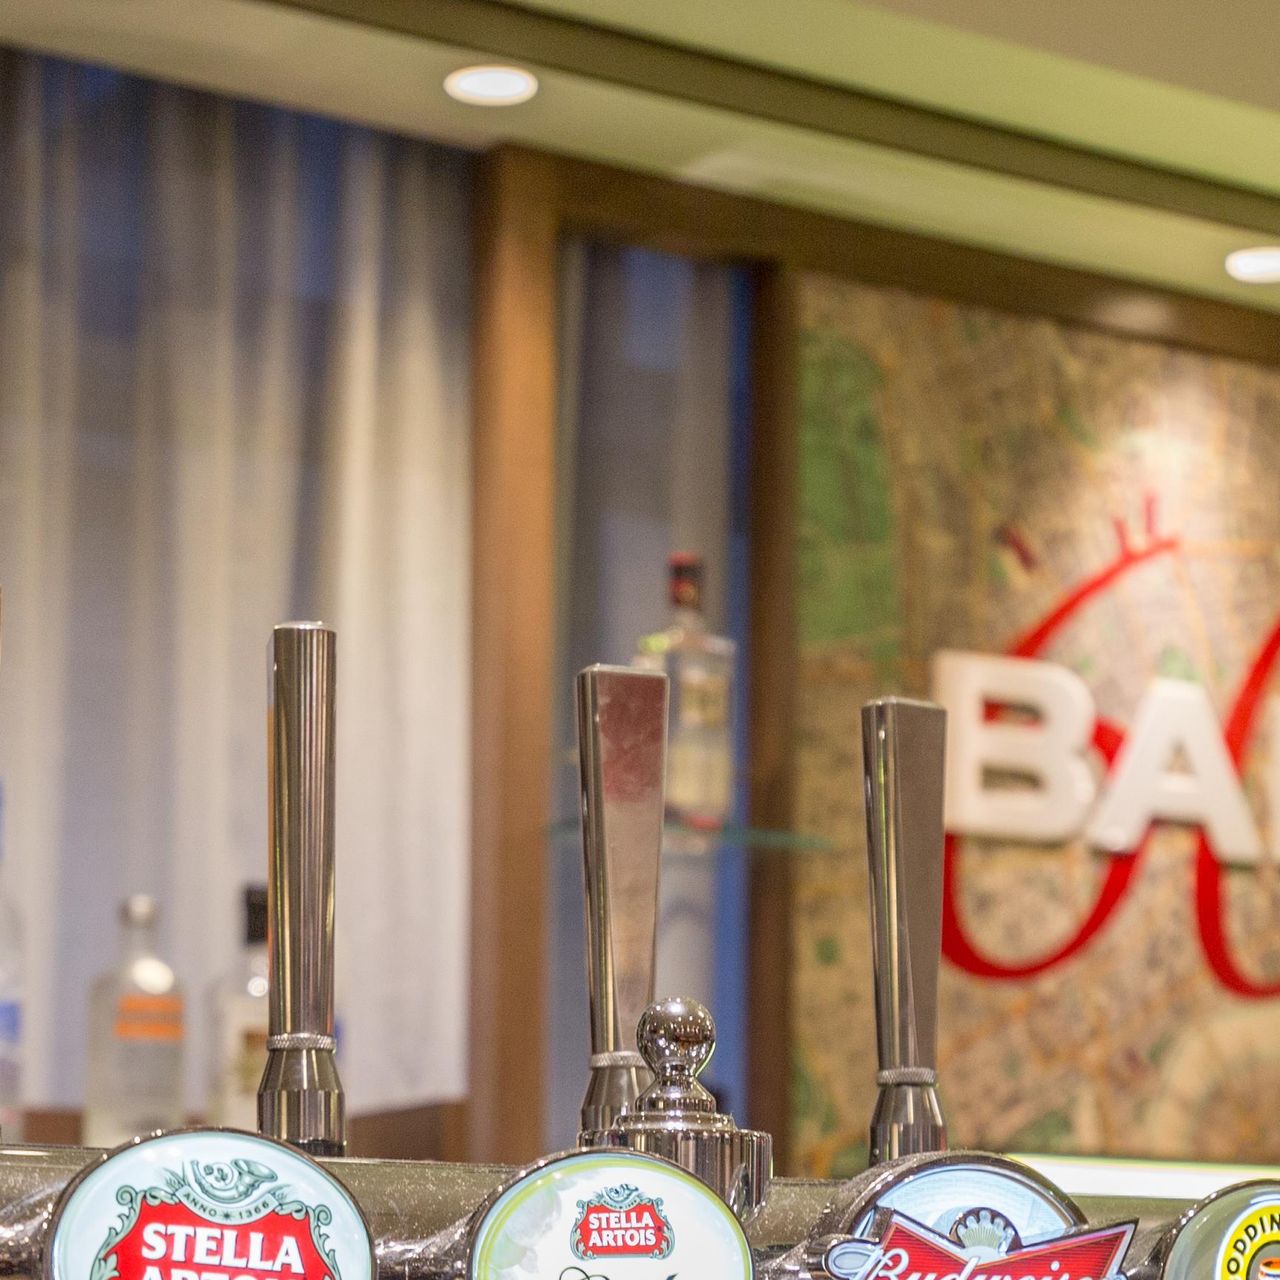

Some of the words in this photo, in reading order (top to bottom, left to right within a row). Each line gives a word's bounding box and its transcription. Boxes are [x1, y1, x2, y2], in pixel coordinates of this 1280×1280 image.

[183, 1192, 218, 1218] ANNO
[238, 1200, 270, 1220] 1366
[588, 1212, 655, 1230] STELLA
[141, 1222, 305, 1275] STELLA
[588, 1229, 657, 1247] ARTOIS
